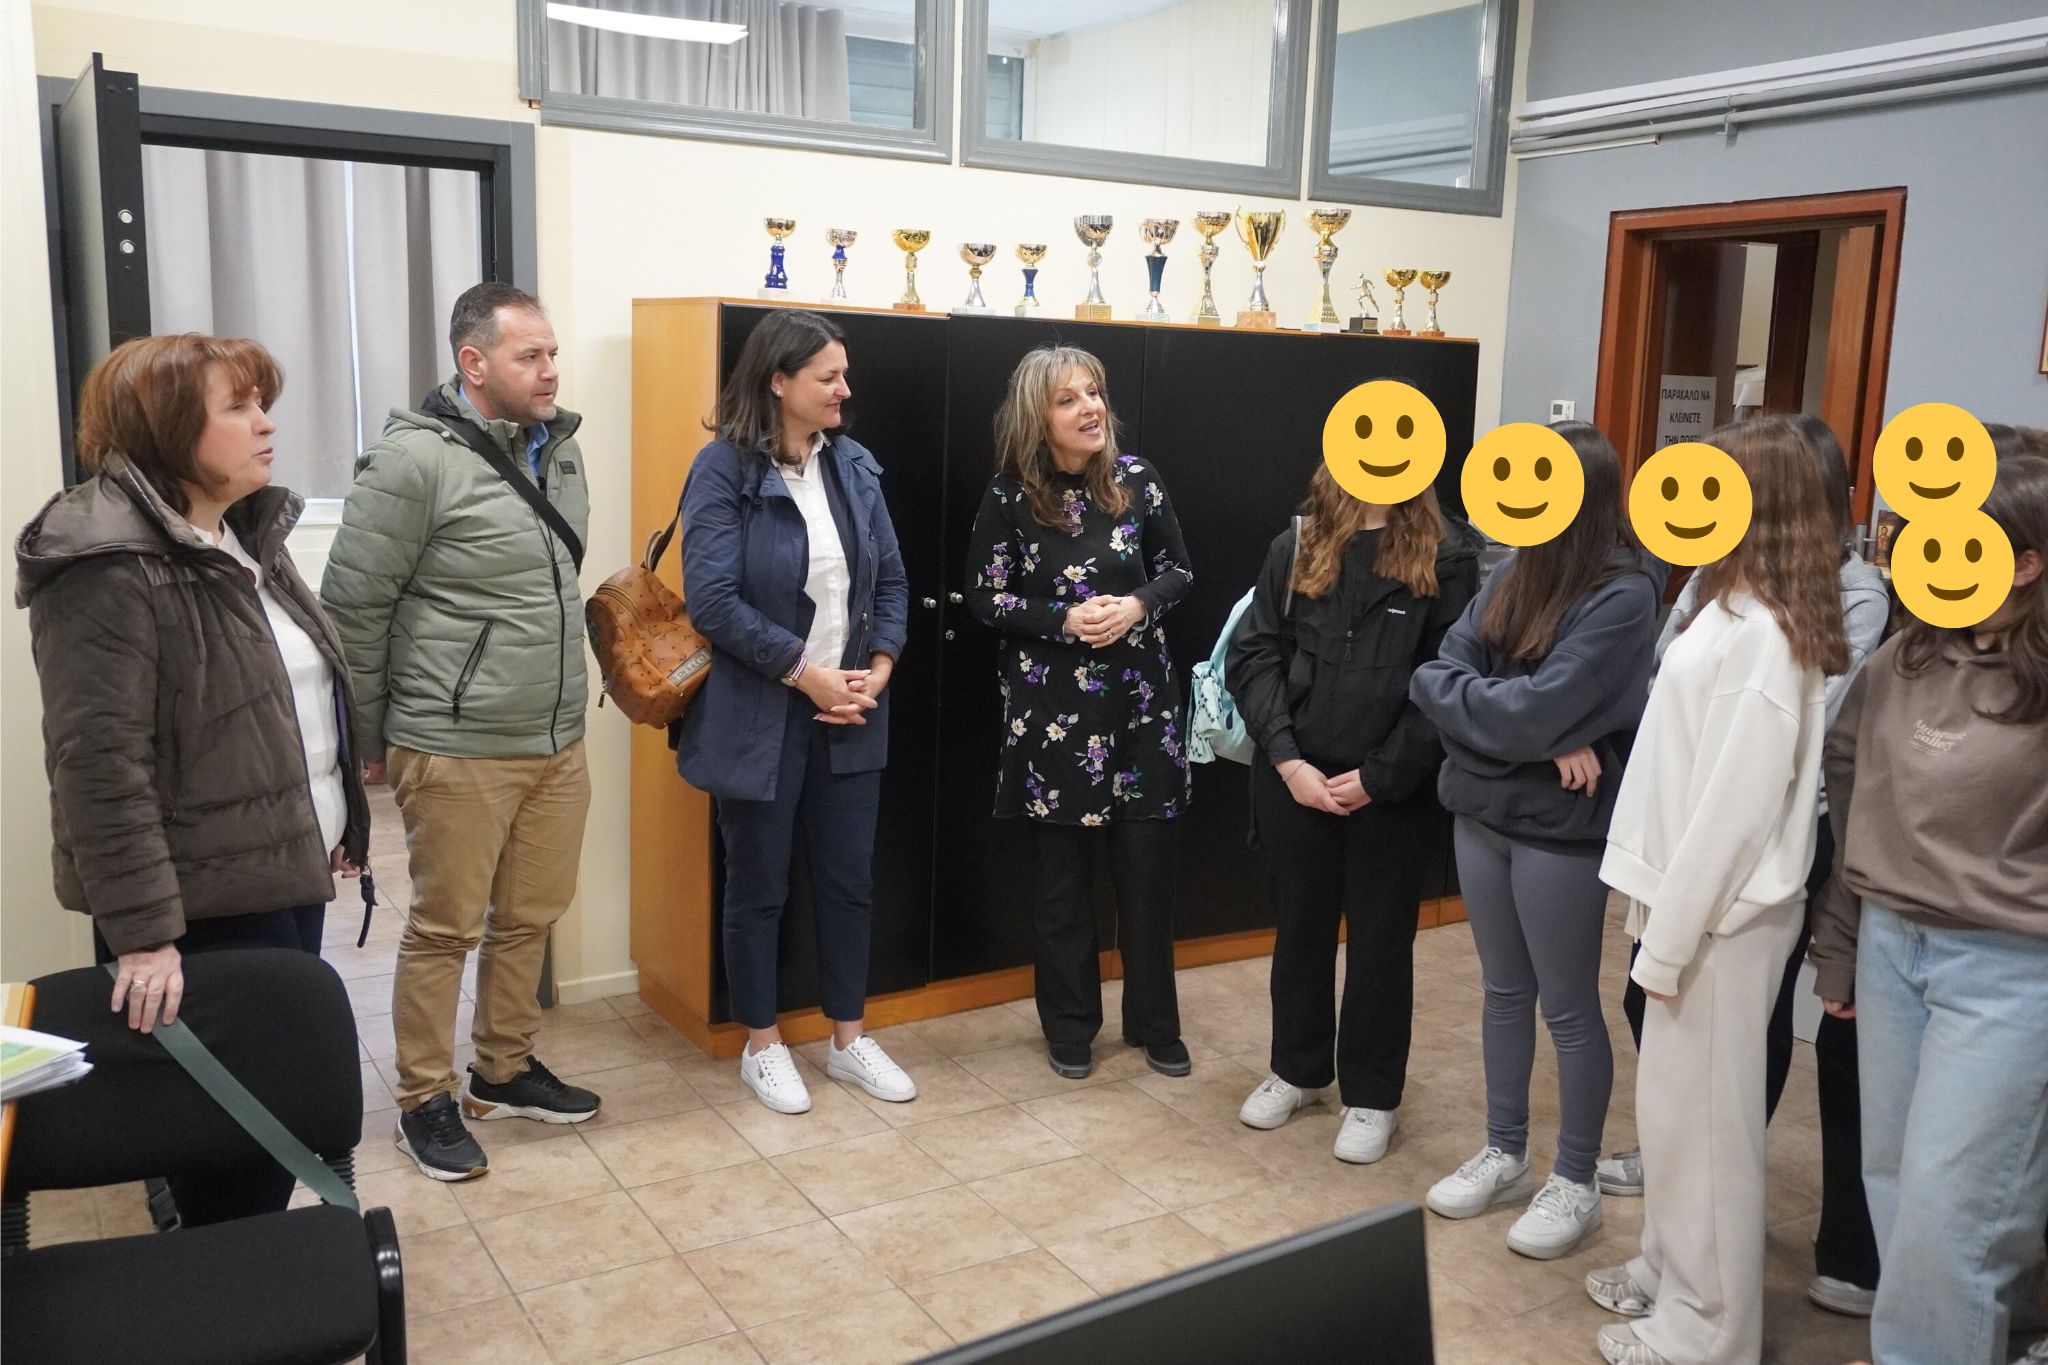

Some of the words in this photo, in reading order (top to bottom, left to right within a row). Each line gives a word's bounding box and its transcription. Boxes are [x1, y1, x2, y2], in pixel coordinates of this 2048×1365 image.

[1662, 389, 1699, 401] ΠΑΡΑΚΑΛΩ
[1701, 390, 1711, 401] ΝΑ
[1670, 412, 1701, 423] ΚΛΕΙΝΕΤΕ
